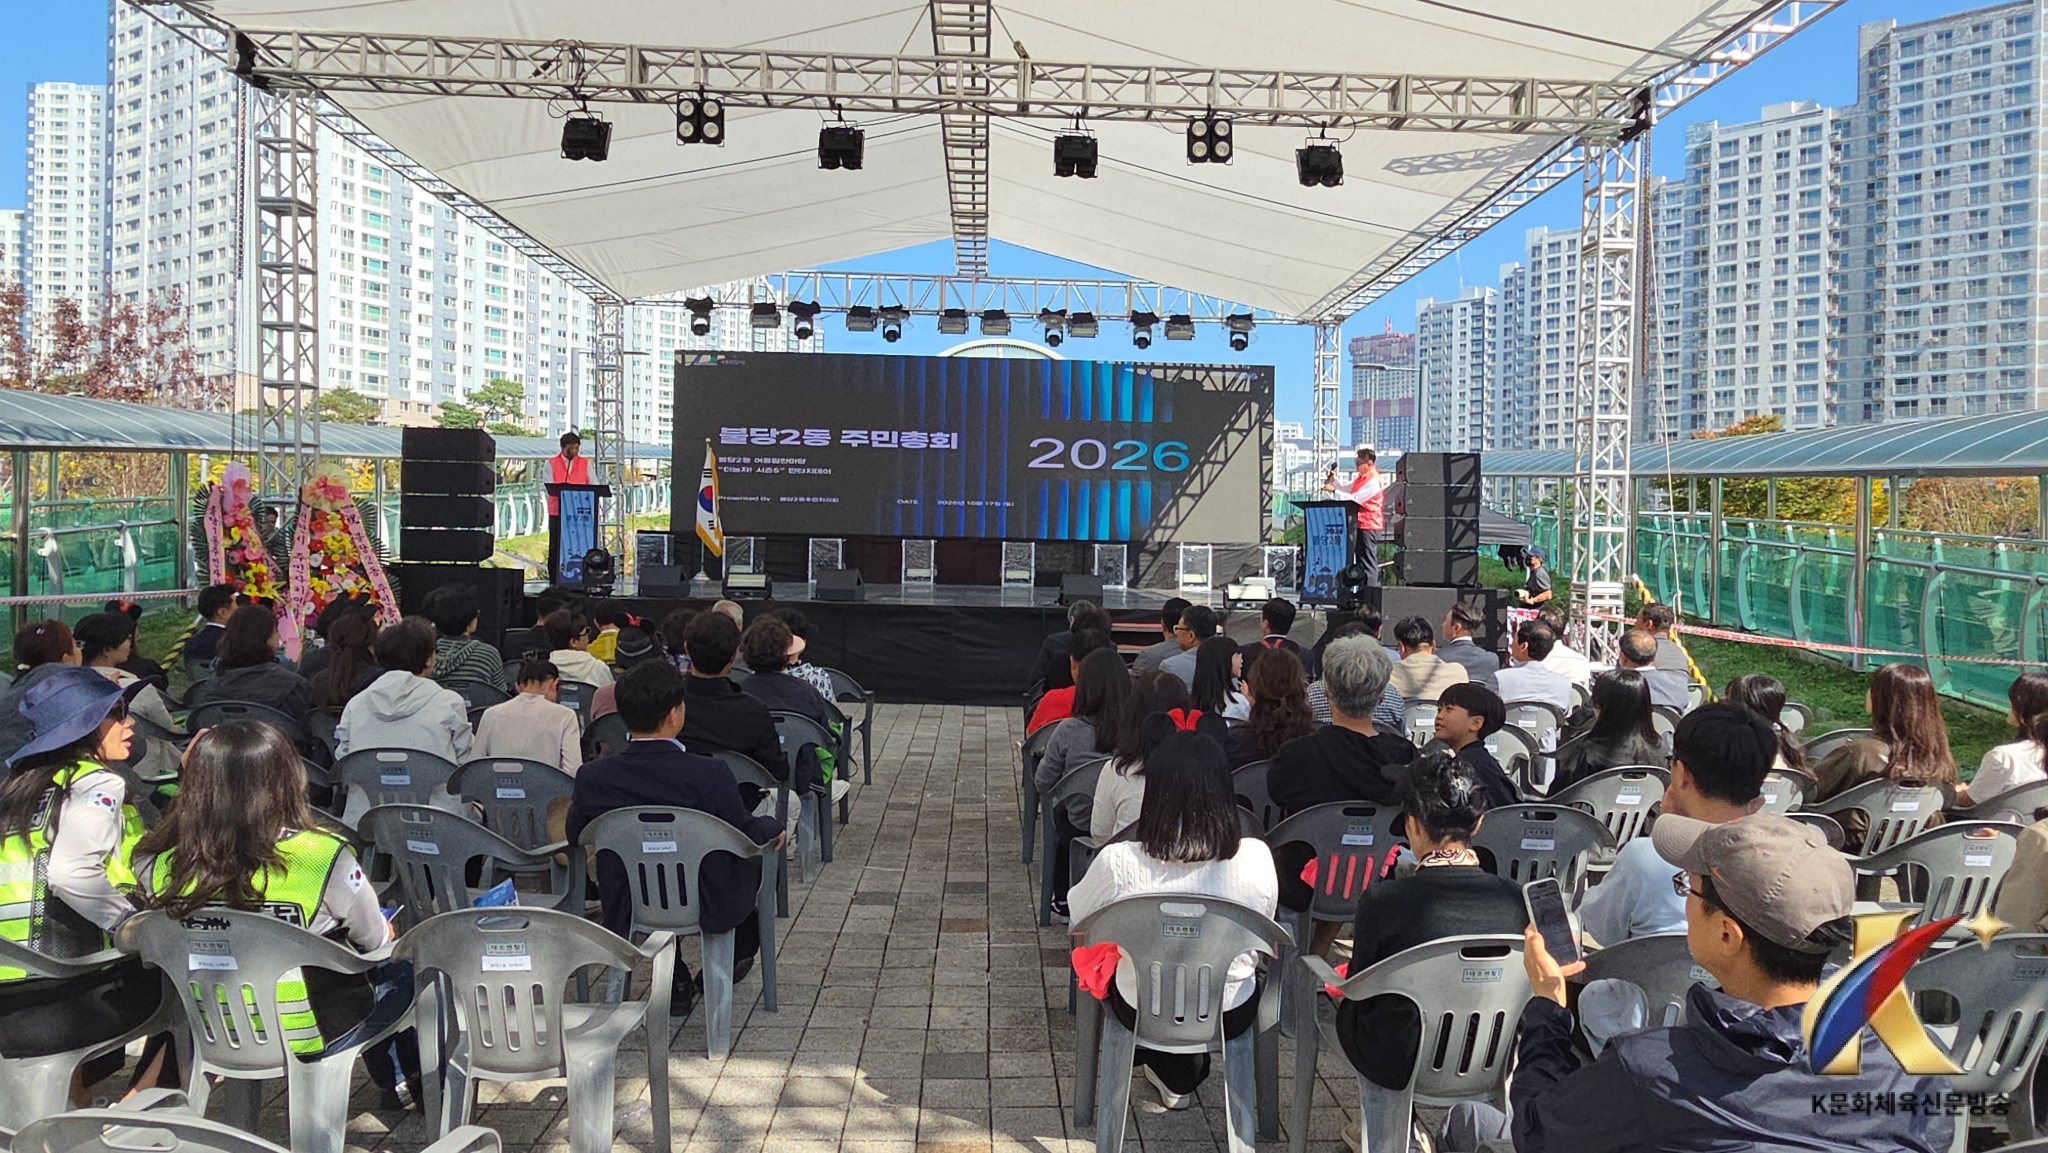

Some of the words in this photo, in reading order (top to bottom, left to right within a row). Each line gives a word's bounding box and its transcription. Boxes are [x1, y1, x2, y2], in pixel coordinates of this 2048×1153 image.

[719, 427, 832, 447] 불당2동
[840, 429, 958, 449] 주민총회
[1028, 438, 1190, 472] 2026
